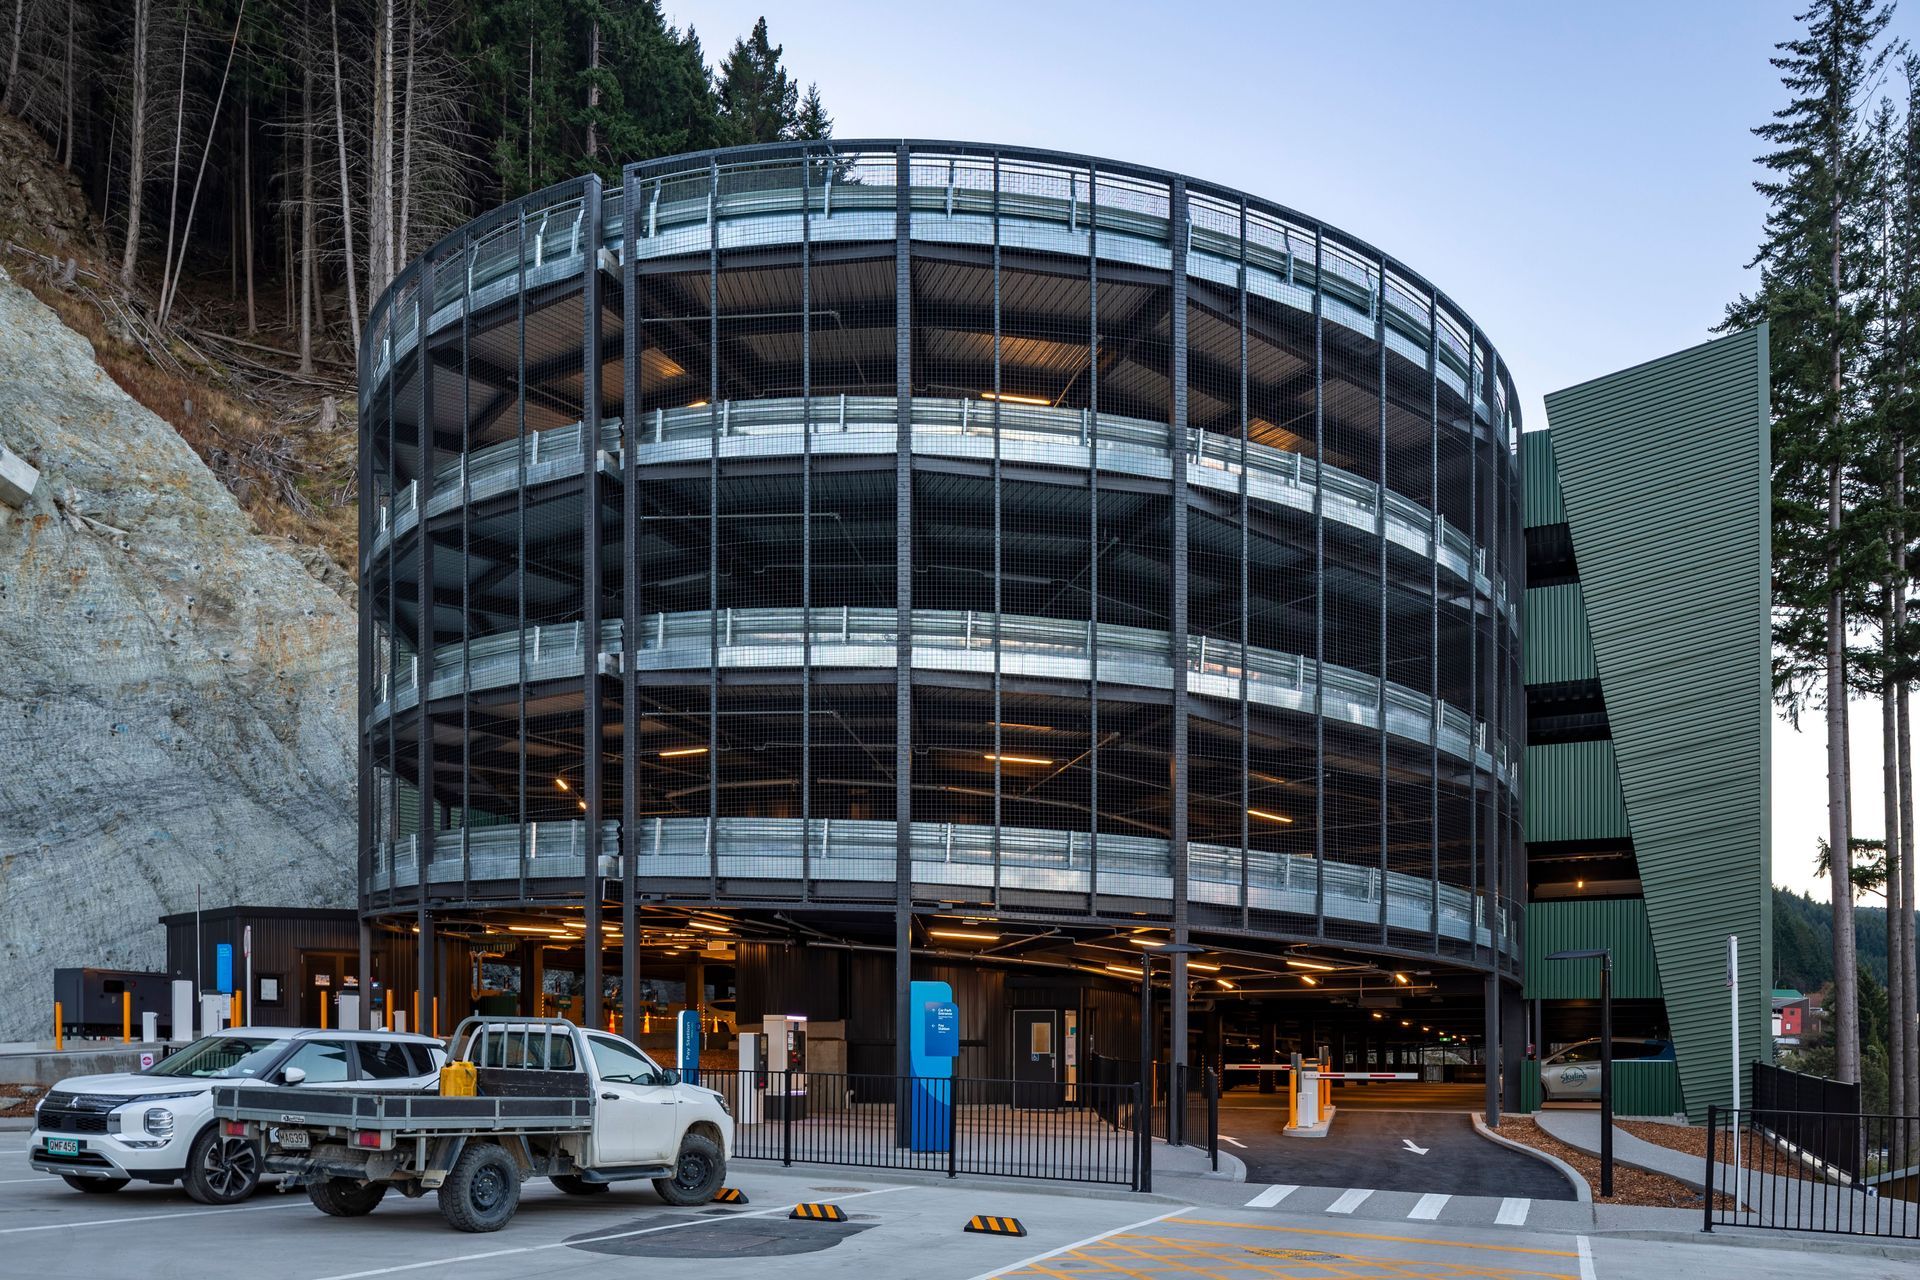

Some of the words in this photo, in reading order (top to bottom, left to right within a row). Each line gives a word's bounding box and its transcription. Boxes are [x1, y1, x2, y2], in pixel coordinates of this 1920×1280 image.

[1560, 1072, 1587, 1083] Skyline
[280, 1131, 307, 1143] MAG397
[49, 1140, 77, 1152] QMF456
